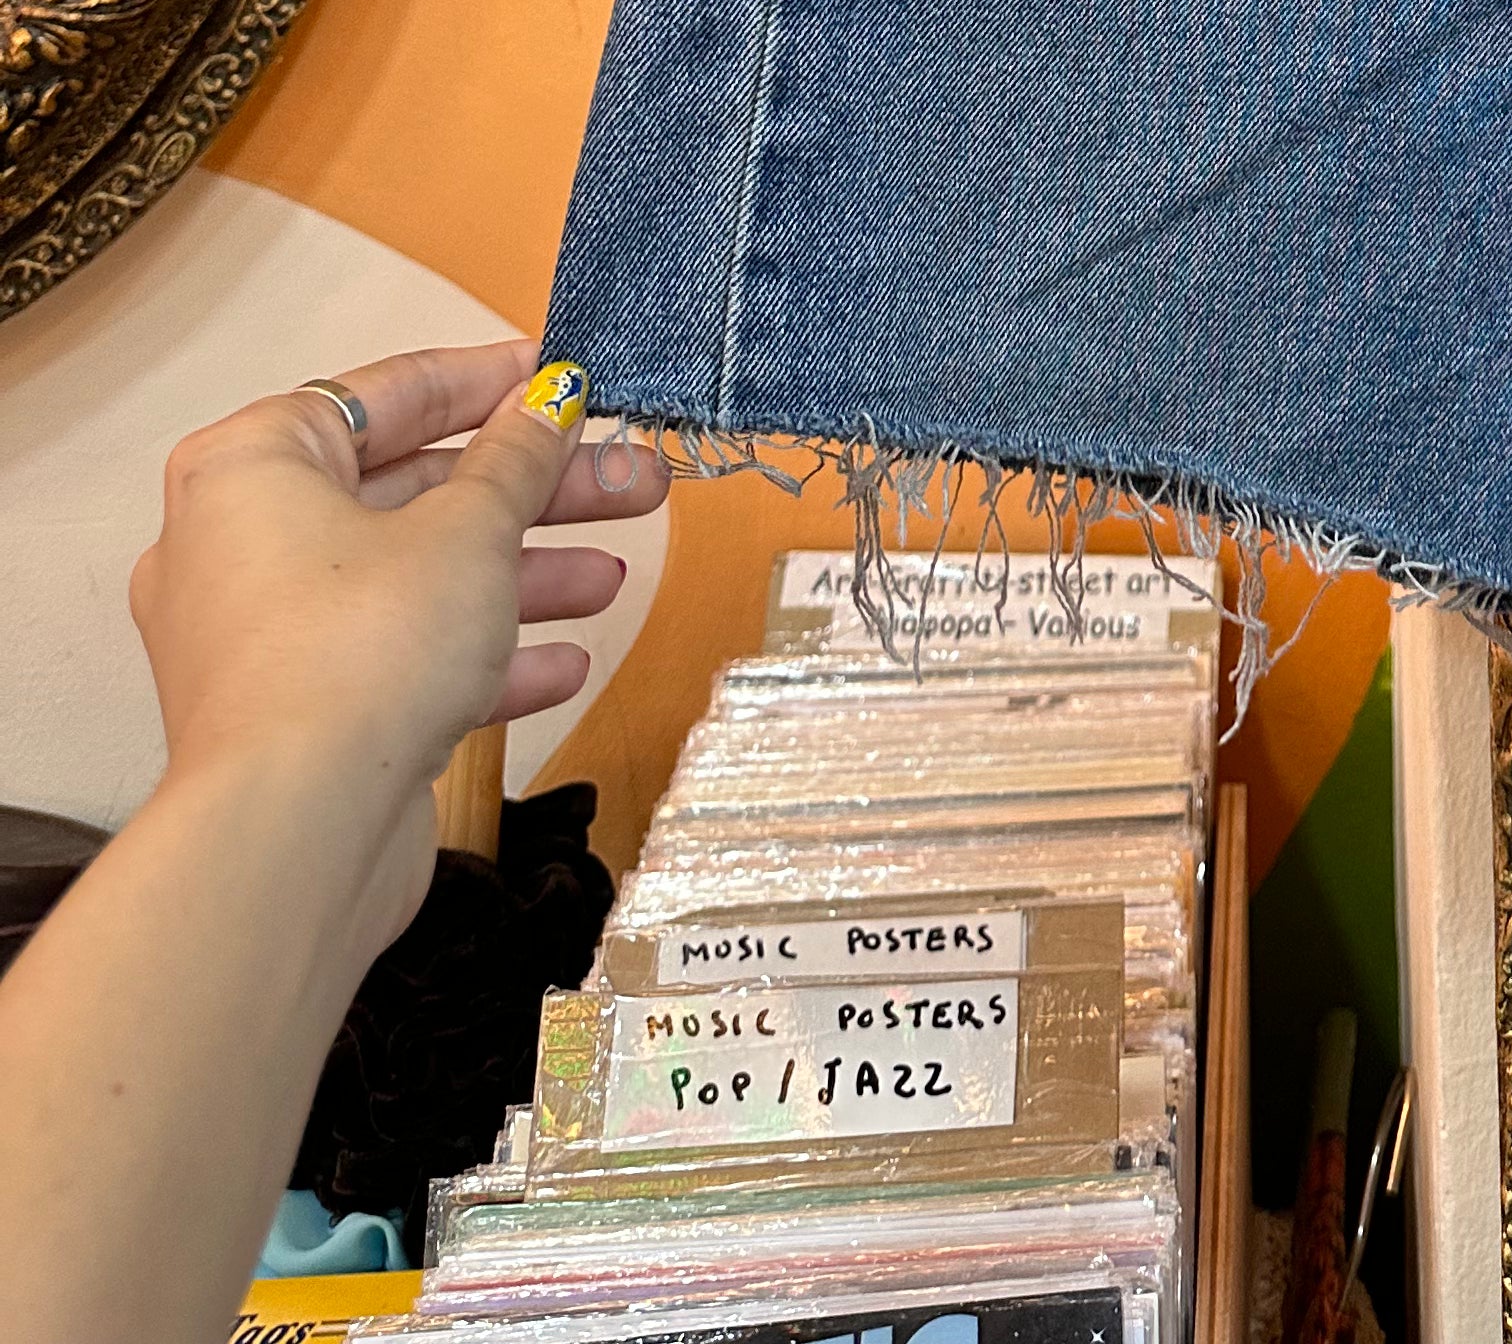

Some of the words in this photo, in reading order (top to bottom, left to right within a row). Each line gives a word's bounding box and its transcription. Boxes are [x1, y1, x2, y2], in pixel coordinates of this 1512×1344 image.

[847, 923, 993, 955] POSTERS
[838, 994, 1006, 1031] POSTERS
[818, 1057, 952, 1106] JAZZ
